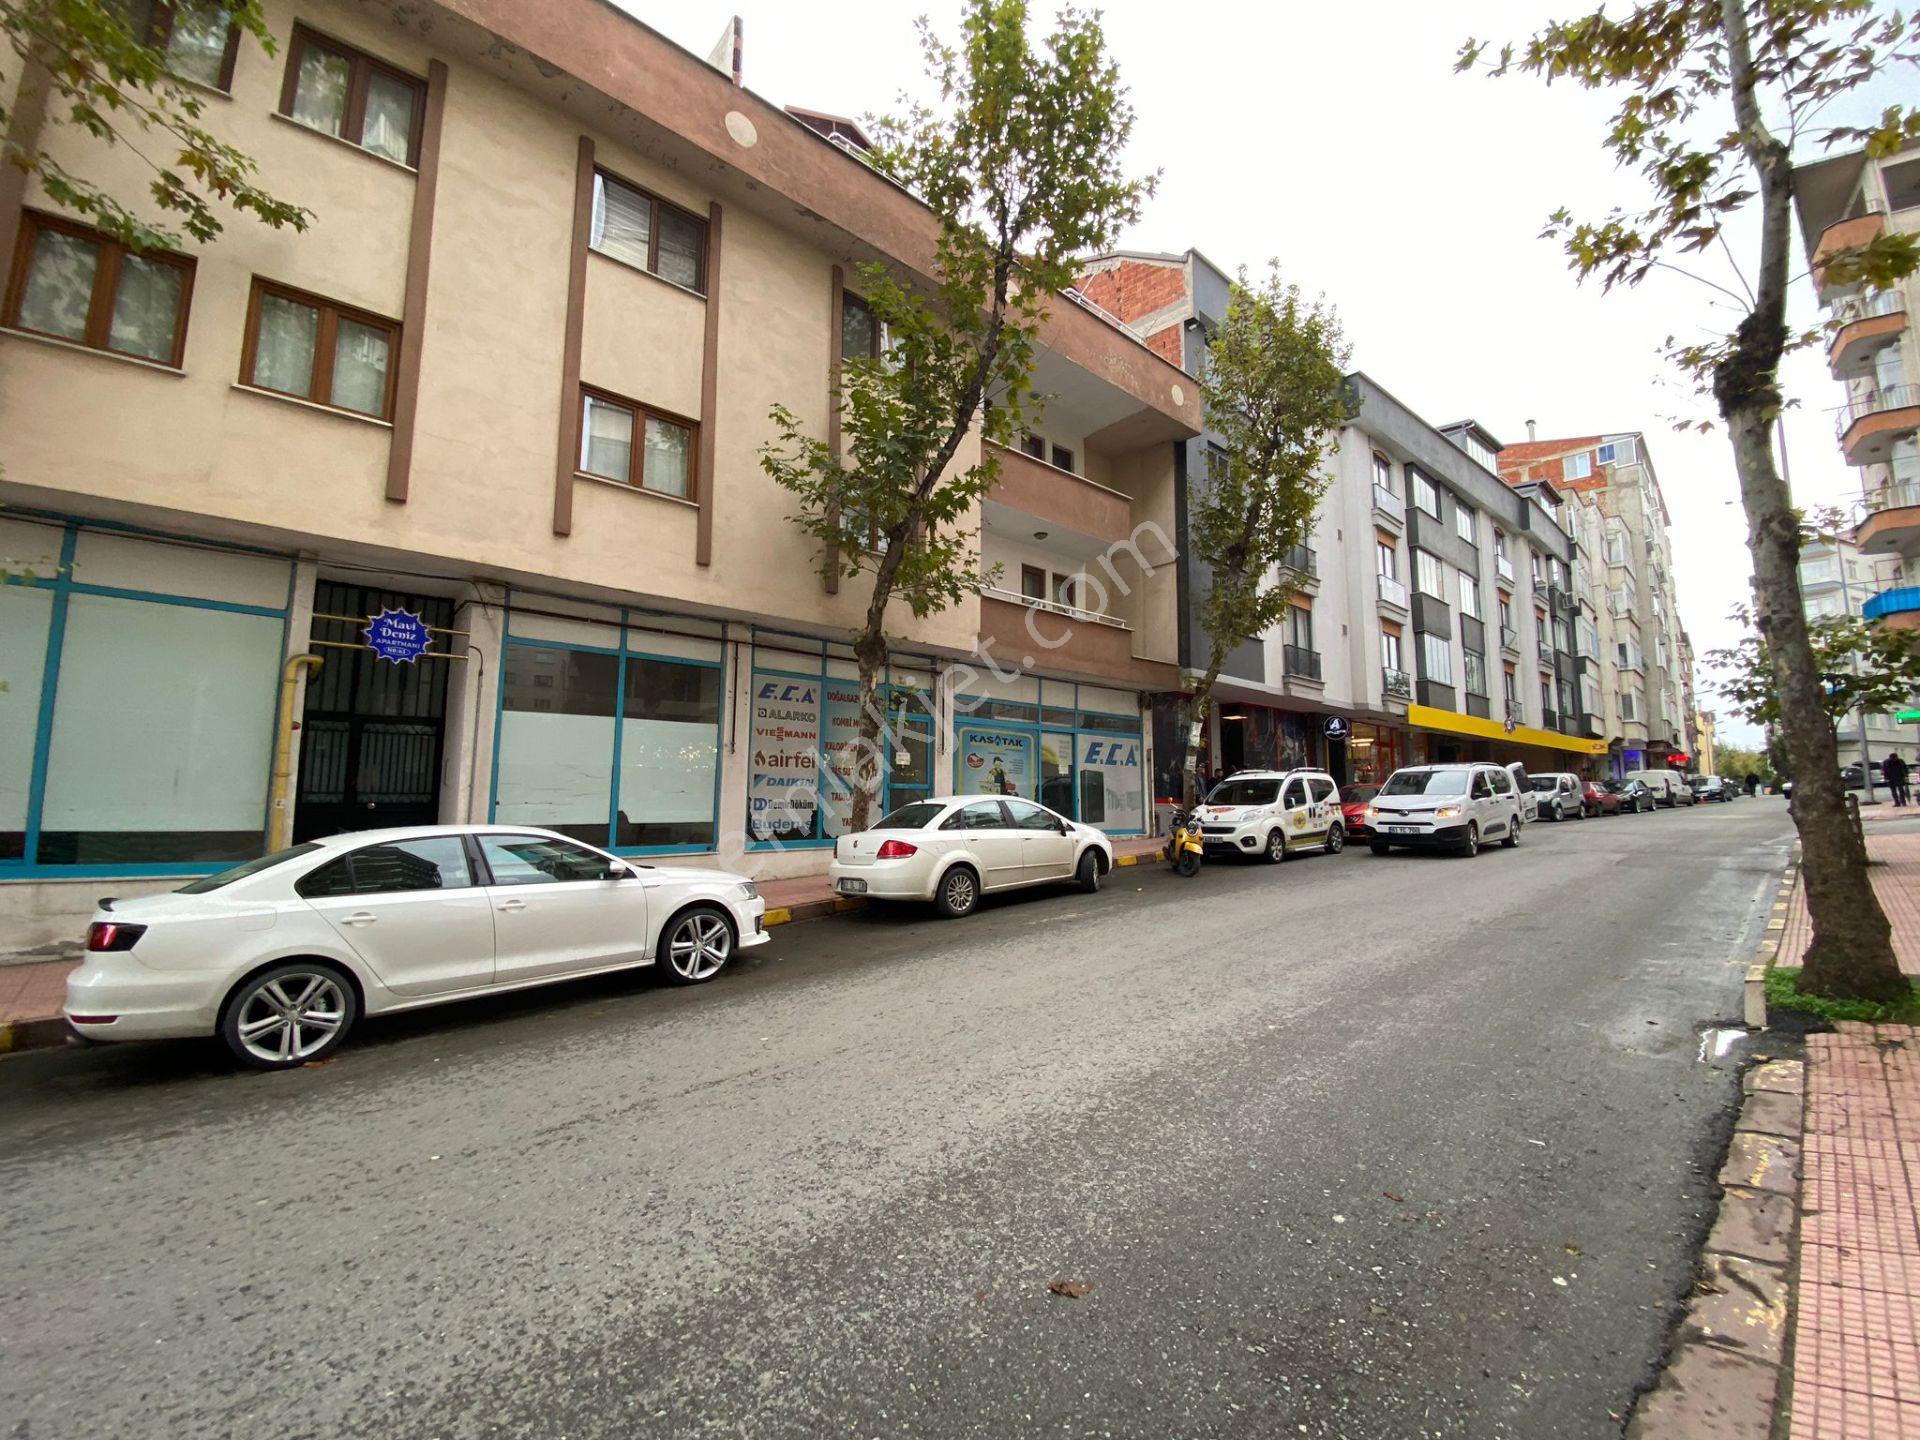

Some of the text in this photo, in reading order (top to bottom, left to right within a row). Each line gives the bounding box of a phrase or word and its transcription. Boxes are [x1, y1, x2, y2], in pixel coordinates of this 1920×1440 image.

[384, 618, 416, 630] Mavi
[380, 627, 416, 640] Deniz
[768, 709, 817, 723] ALARKO
[767, 777, 815, 787] DAIKIN
